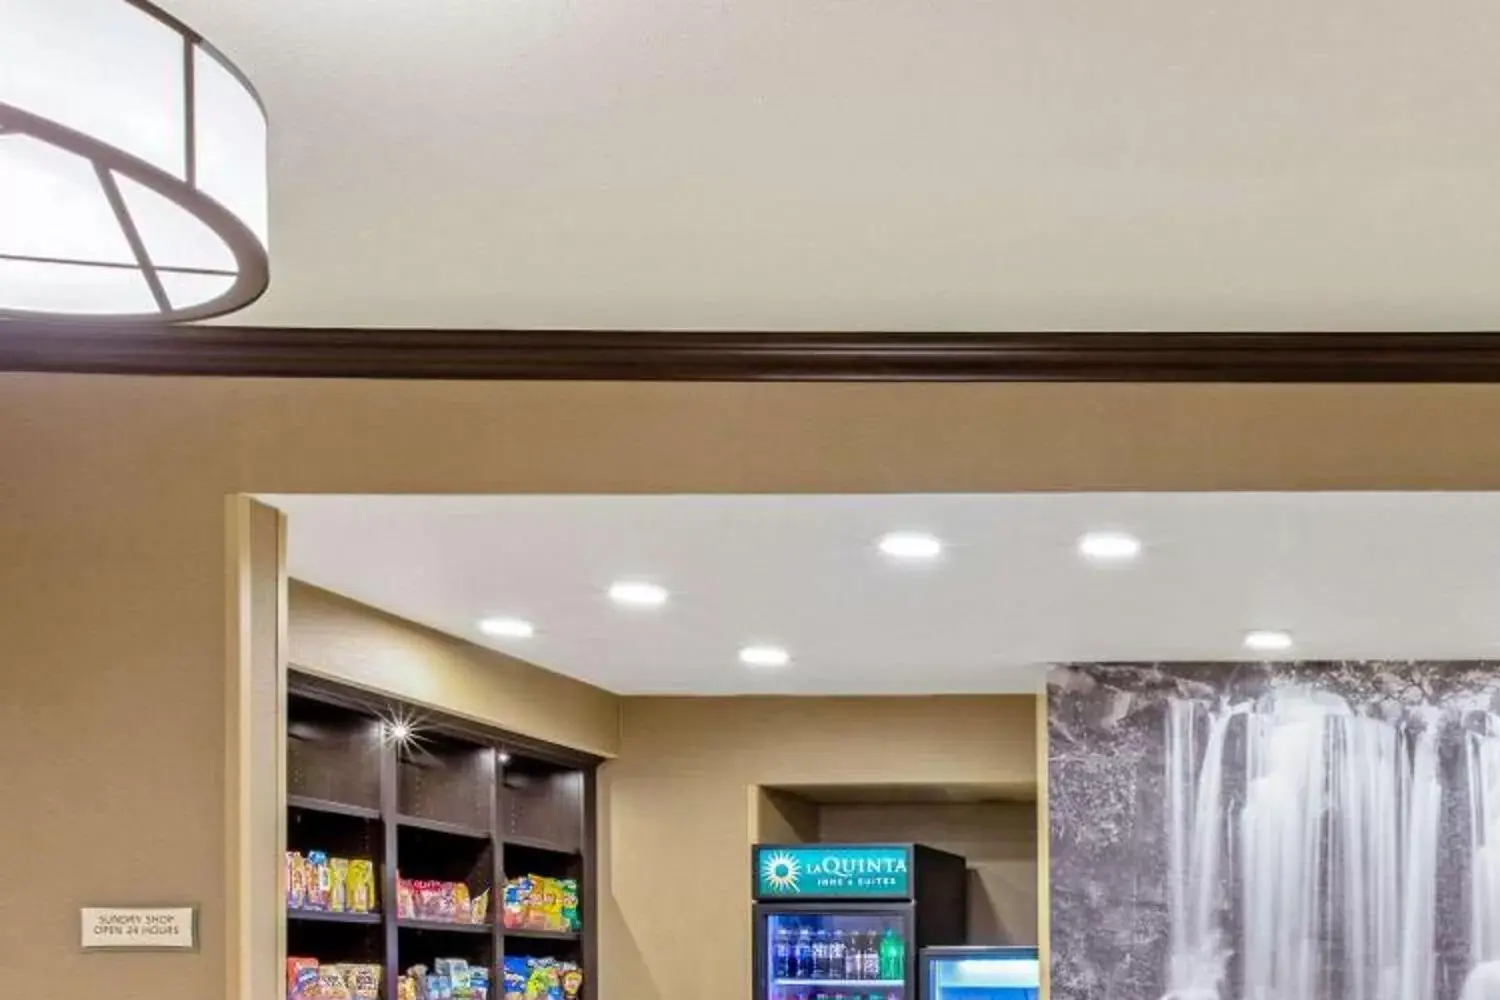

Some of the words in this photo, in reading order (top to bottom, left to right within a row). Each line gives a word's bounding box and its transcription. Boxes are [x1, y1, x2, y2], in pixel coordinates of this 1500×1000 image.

[821, 856, 908, 877] QUINTA
[93, 925, 123, 935] OPEN
[125, 925, 139, 935] 24
[141, 925, 180, 935] HOURS
